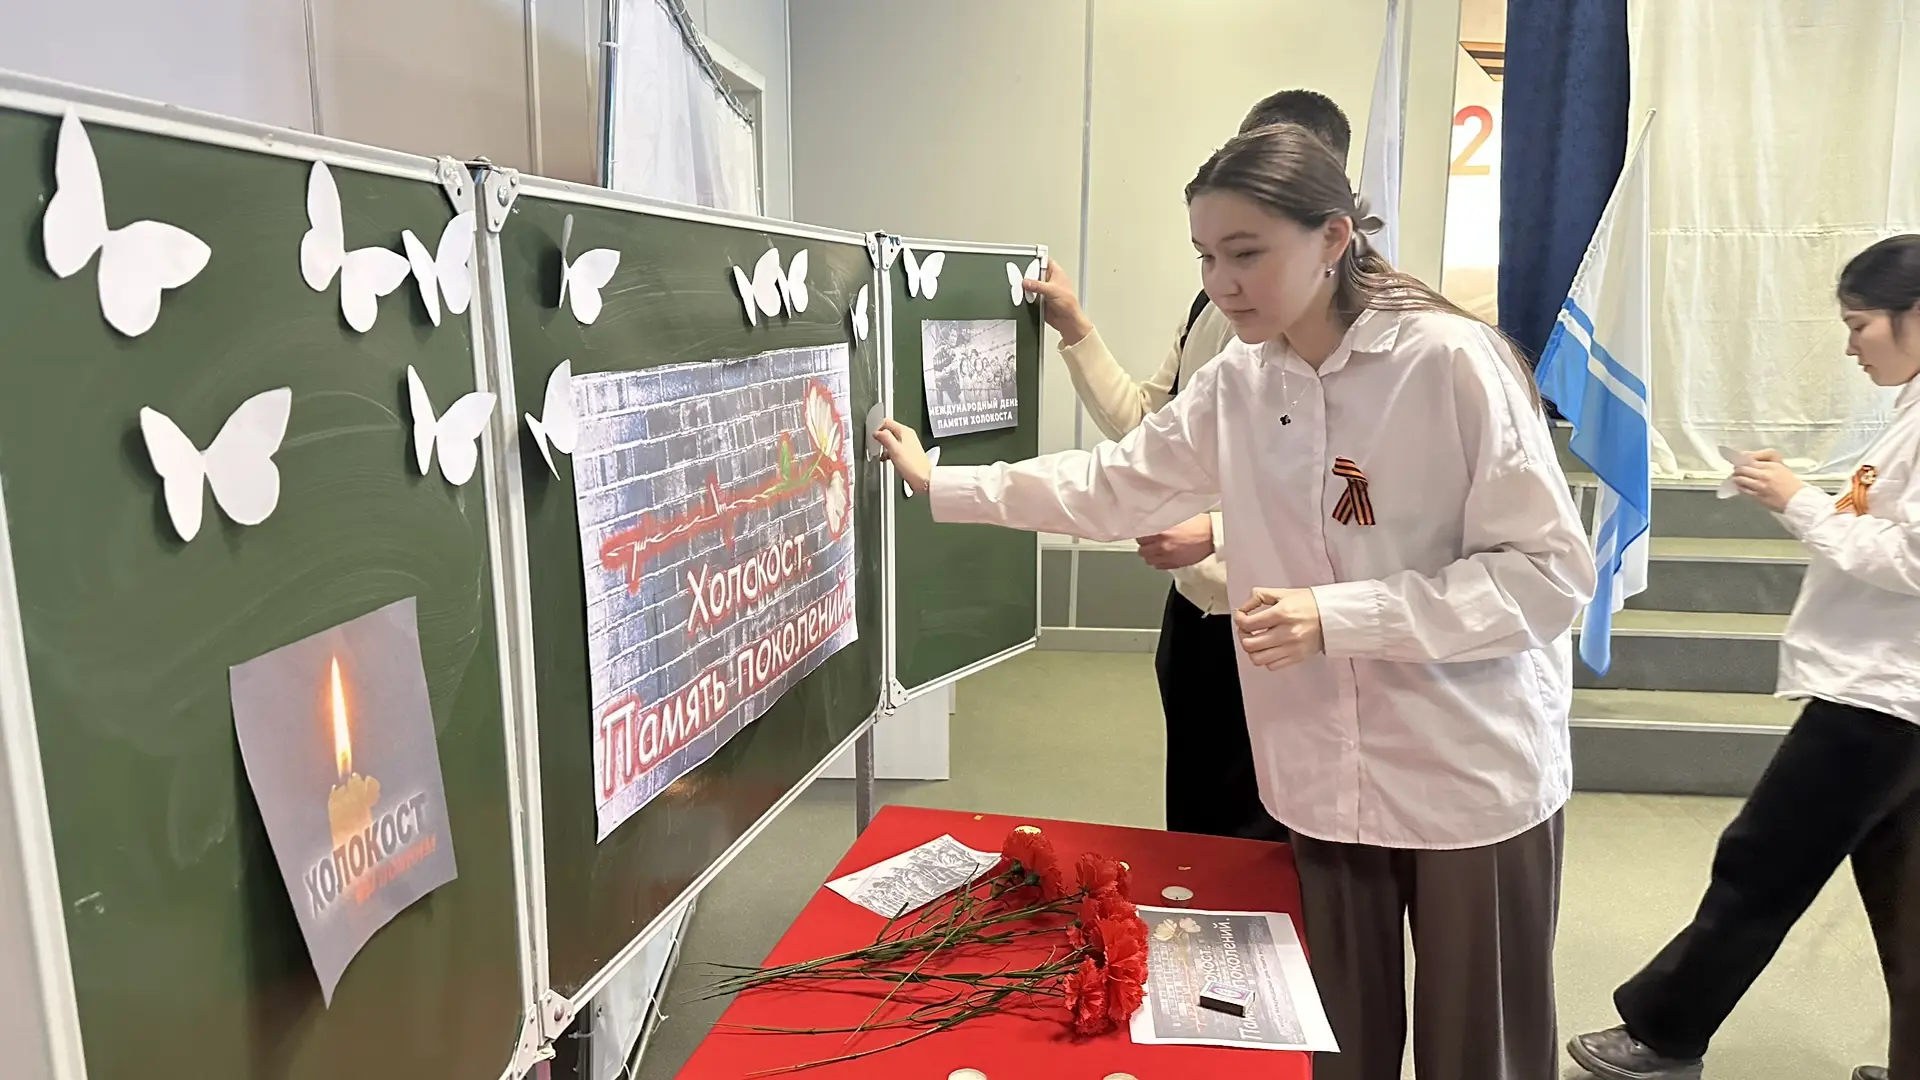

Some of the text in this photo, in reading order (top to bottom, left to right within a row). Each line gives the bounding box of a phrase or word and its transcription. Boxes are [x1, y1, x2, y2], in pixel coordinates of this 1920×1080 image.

[929, 398, 1018, 416] МЕЖДУНАРОДНЫЙ ДЕНЬ
[938, 411, 1013, 429] ПАМЯТИ ХОЛОКОСТА
[687, 533, 812, 634] Холокост.
[601, 571, 852, 791] Память поколений.
[305, 793, 427, 916] ХОЛОКОСТ
